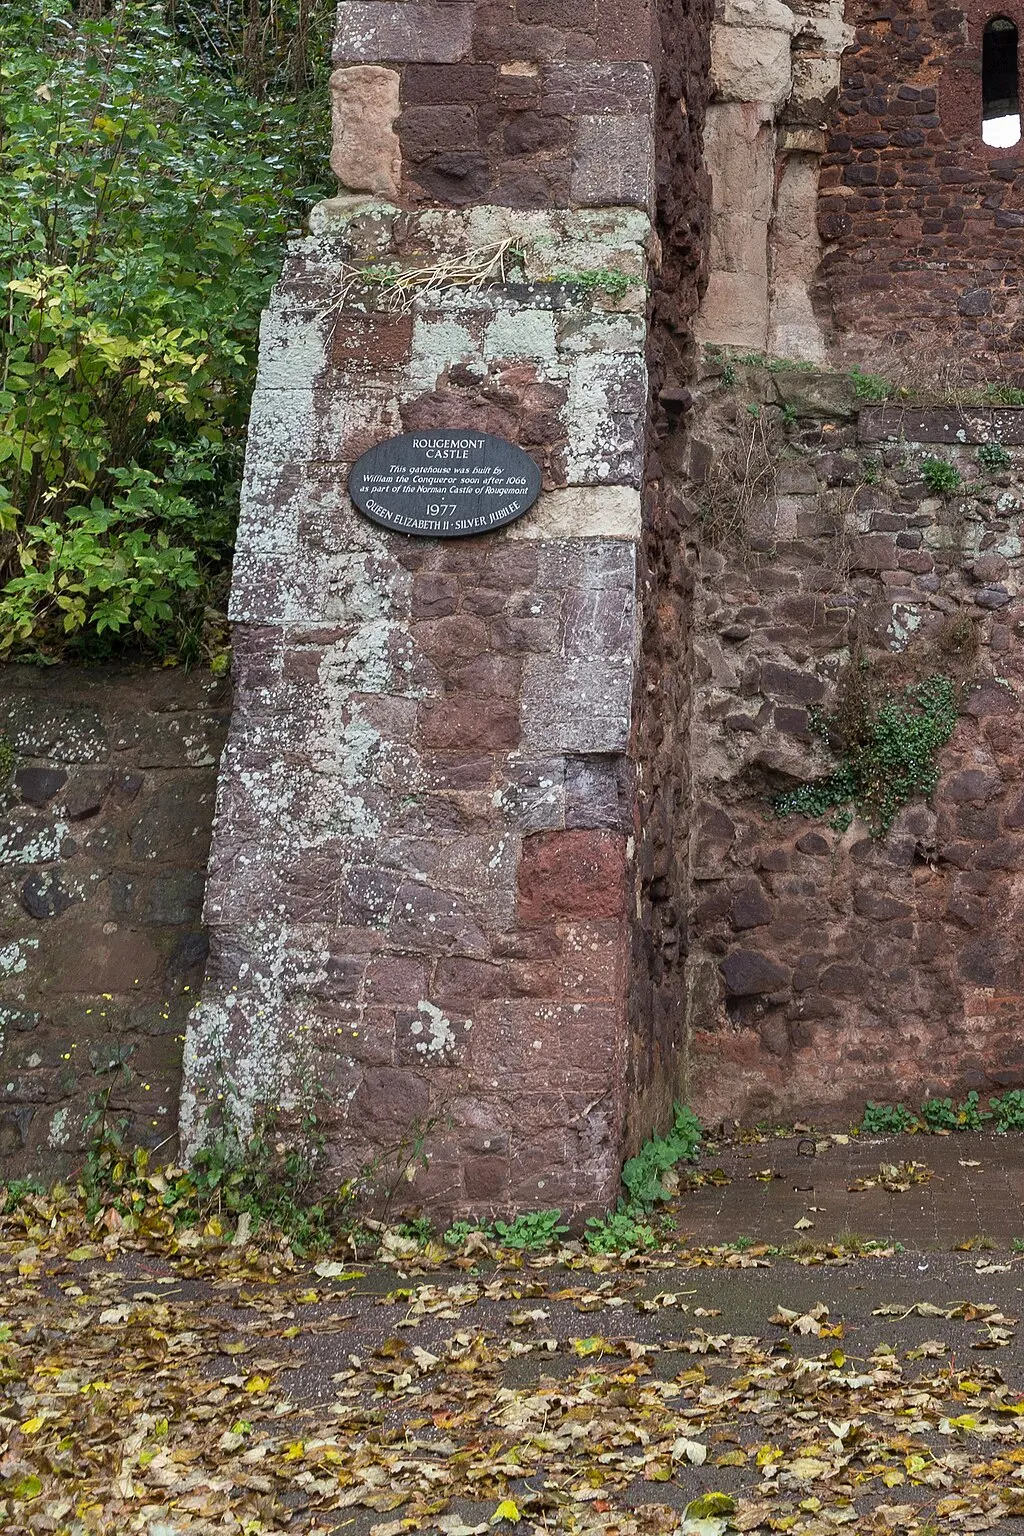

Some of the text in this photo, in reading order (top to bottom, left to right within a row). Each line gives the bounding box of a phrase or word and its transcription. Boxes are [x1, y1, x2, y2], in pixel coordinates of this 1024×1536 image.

[412, 438, 486, 449] ROUGEMONT
[426, 449, 469, 459] CASTLE
[389, 465, 407, 473] This
[409, 465, 452, 475] gatehouse
[472, 466, 491, 474] built
[493, 466, 505, 476] by
[363, 474, 393, 483] William
[395, 475, 410, 483] the
[412, 475, 457, 485] Conqueror
[482, 476, 504, 485] after
[506, 476, 527, 485] 1066
[370, 486, 390, 494] part
[391, 485, 403, 494] of
[402, 485, 416, 493] the
[416, 485, 447, 493] Norman
[449, 485, 473, 494] Castle
[474, 486, 485, 496] of
[485, 485, 529, 497] Rougemont
[365, 499, 521, 530] QUEEN ELIZABETH II SILVER JUBILEE
[426, 504, 458, 516] 1977
